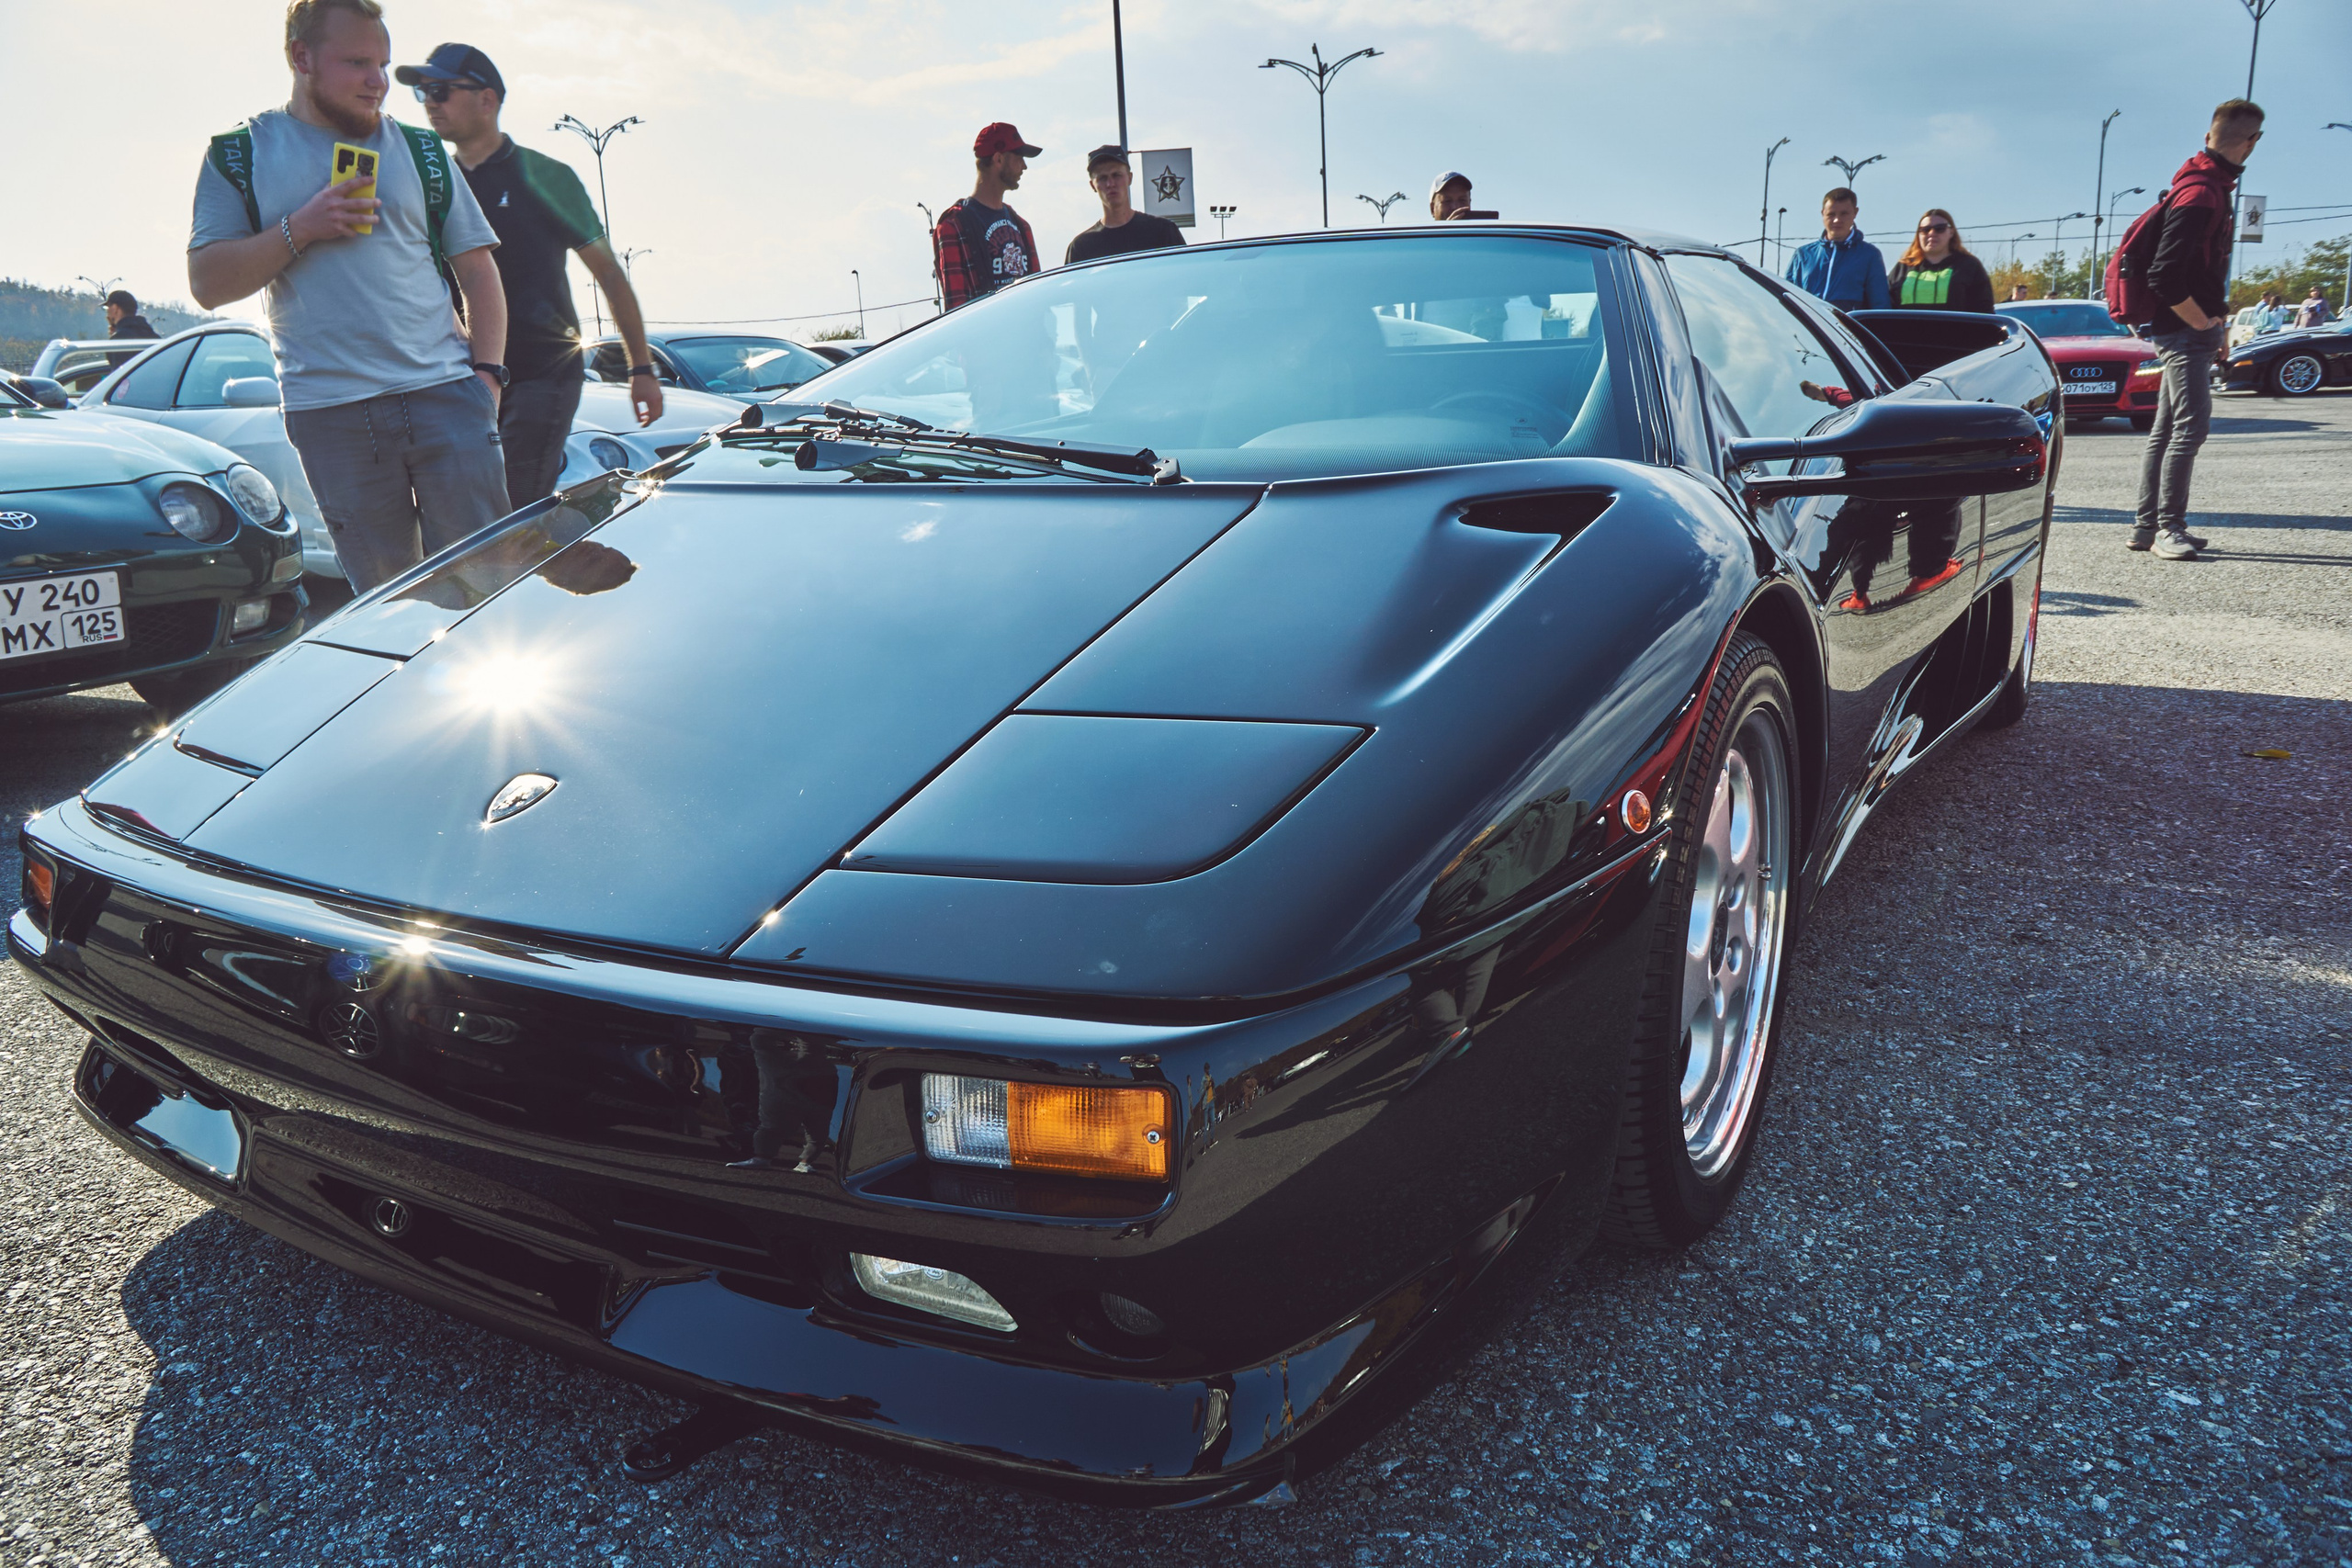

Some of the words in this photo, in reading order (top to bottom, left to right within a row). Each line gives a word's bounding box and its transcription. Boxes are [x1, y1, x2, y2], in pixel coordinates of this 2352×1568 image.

[414, 130, 444, 204] TAKATA
[2098, 382, 2113, 390] 125
[40, 579, 99, 611] 240
[72, 611, 117, 636] 125
[82, 634, 103, 643] RUS
